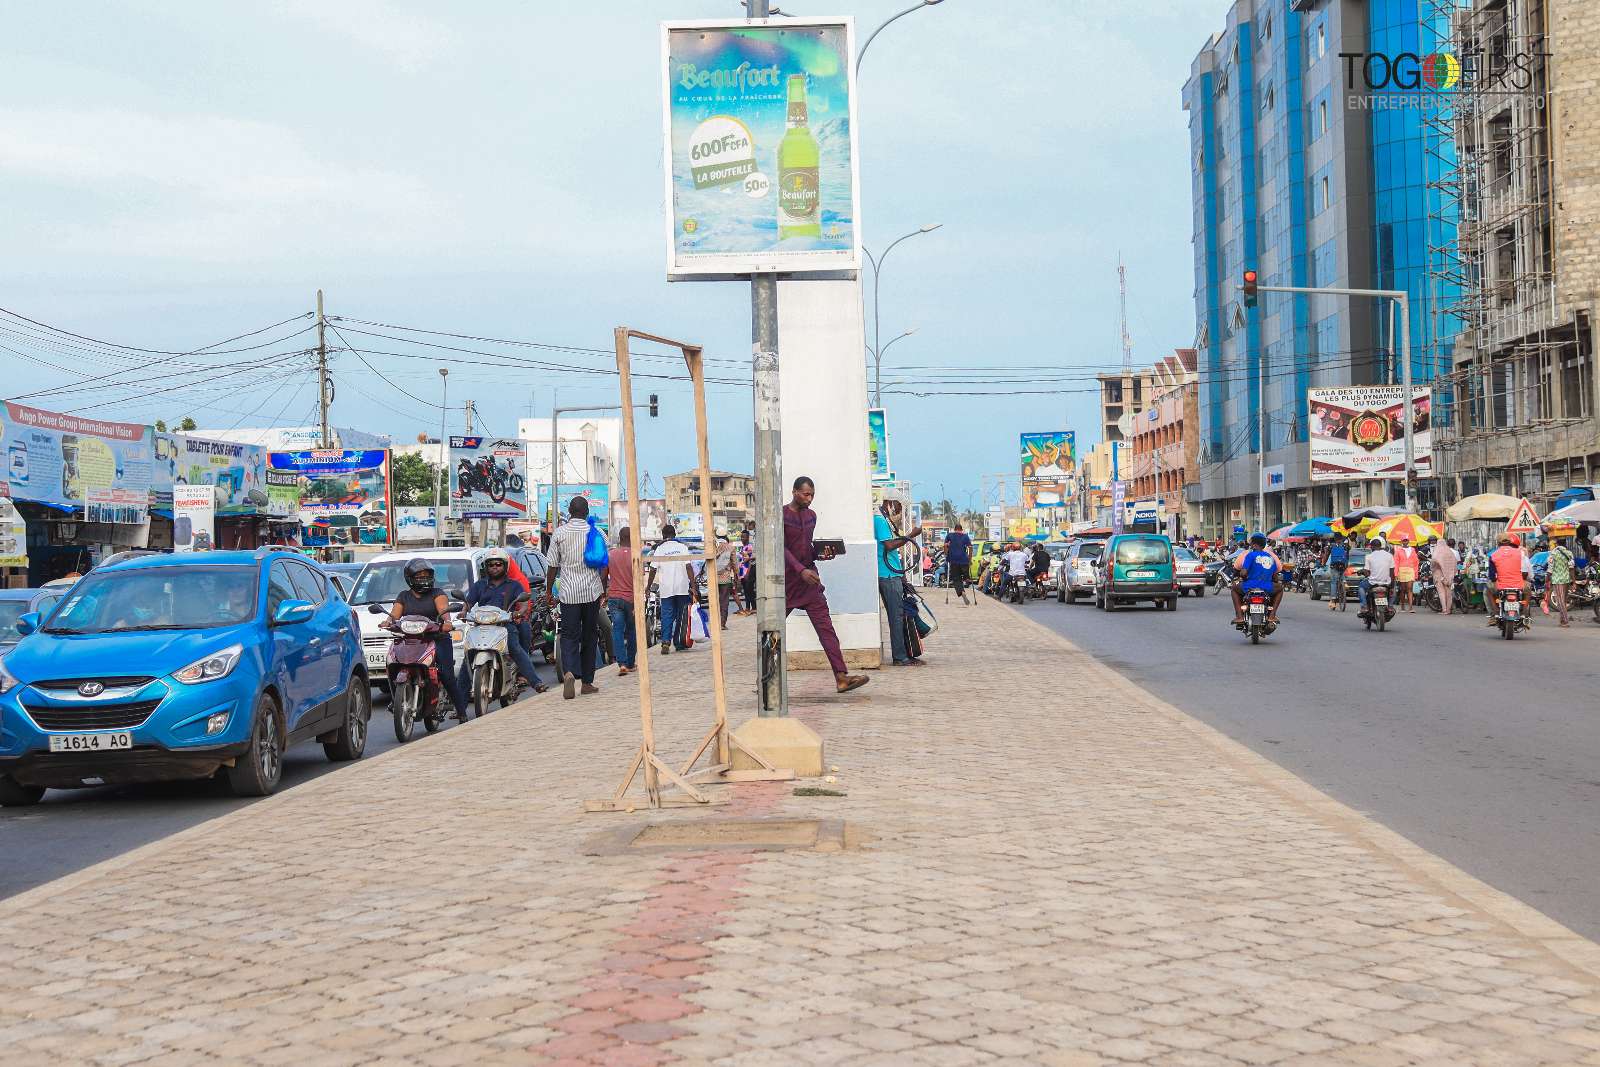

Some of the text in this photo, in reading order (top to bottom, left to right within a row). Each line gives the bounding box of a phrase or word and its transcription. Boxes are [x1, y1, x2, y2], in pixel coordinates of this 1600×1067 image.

[678, 61, 780, 95] Beaufort
[697, 164, 752, 183] LA BOUTEILLE
[782, 189, 816, 200] Beaufort
[19, 409, 133, 438] Ango Power Group International Vision
[186, 440, 243, 457] TABLETTE POUR ENFANT
[1136, 511, 1157, 519] NOKIA
[63, 734, 128, 749] 1614 AQ
